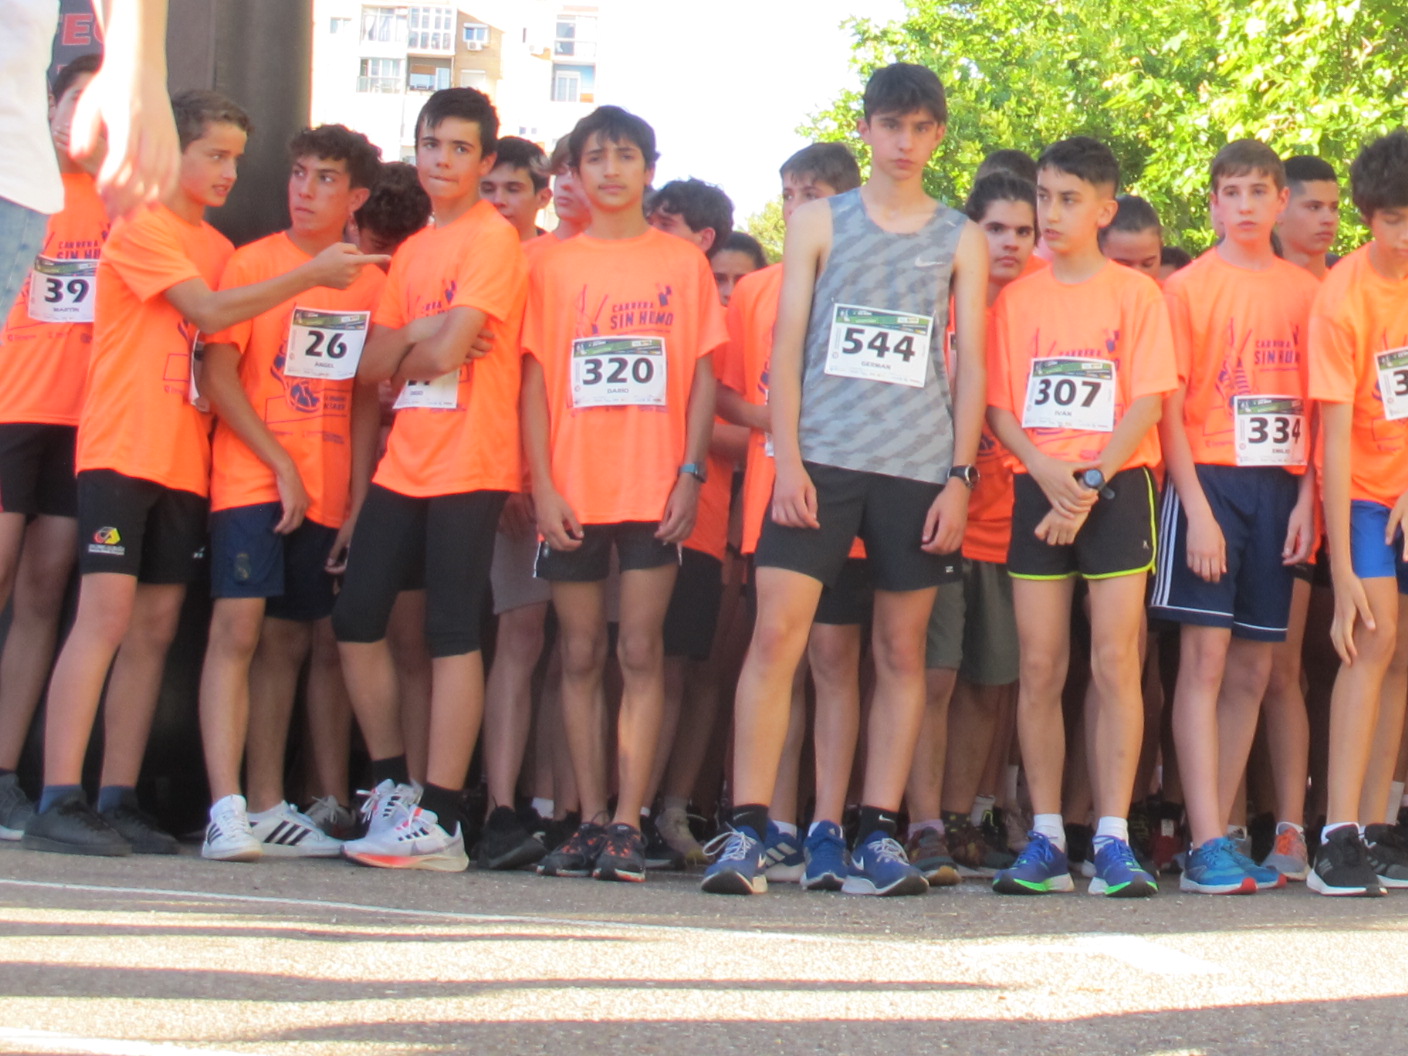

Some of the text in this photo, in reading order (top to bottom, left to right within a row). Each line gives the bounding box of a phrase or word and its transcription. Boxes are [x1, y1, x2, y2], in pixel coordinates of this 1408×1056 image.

[44, 277, 90, 303] 39
[610, 312, 634, 330] SIN
[305, 330, 348, 359] 26
[842, 327, 916, 363] 544
[583, 357, 654, 385] 320
[1034, 378, 1102, 408] 307
[1247, 416, 1301, 445] 334
